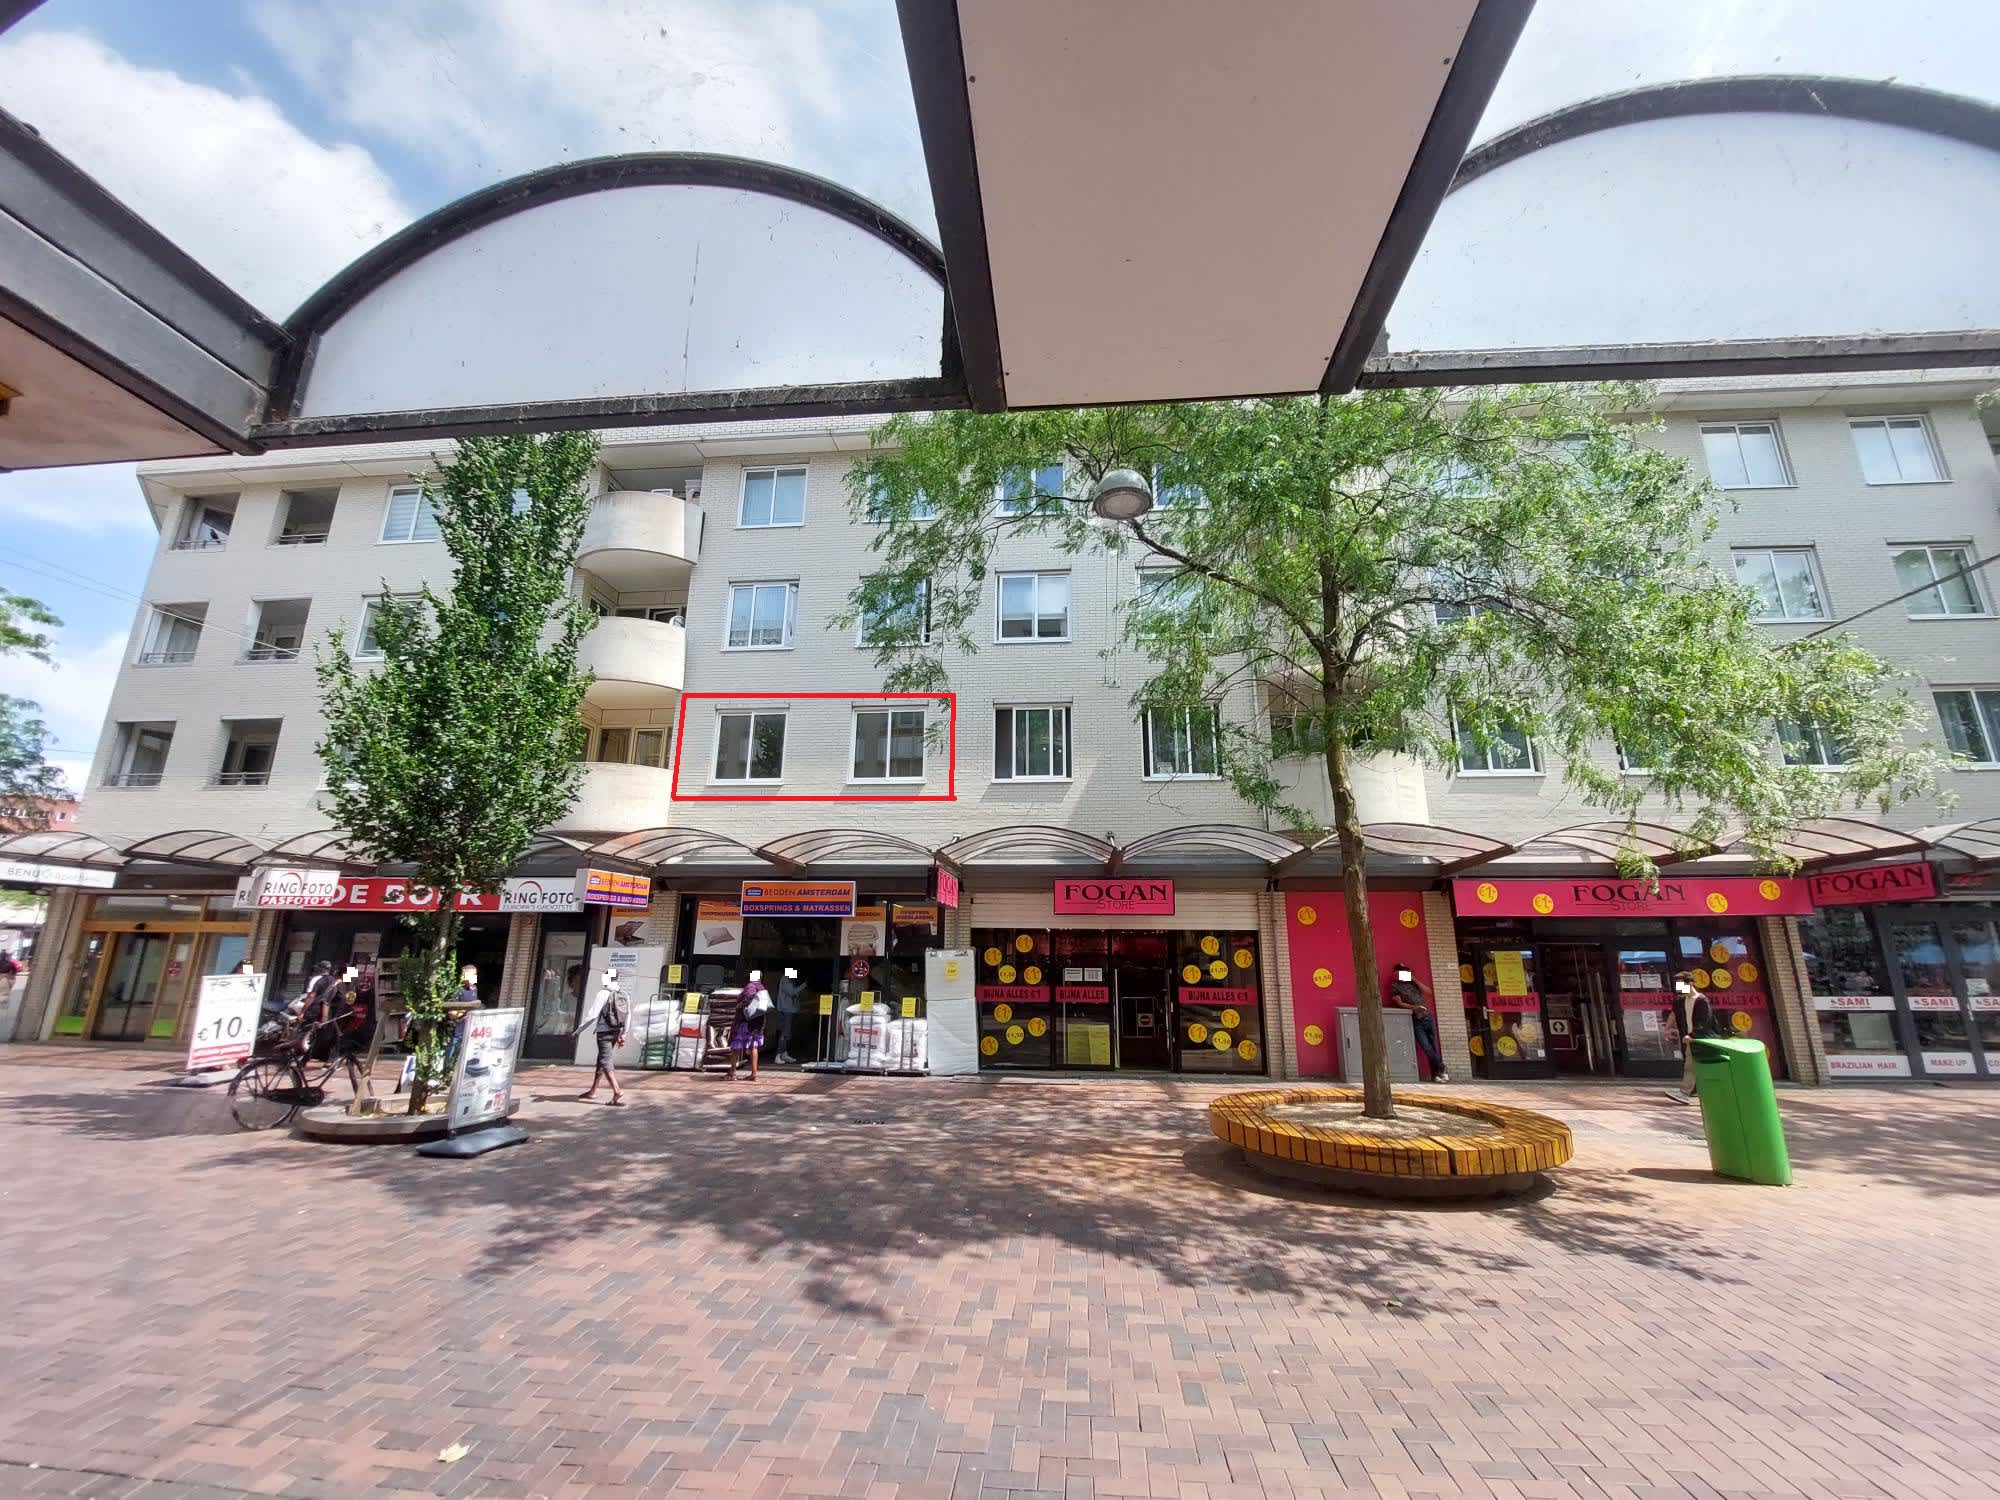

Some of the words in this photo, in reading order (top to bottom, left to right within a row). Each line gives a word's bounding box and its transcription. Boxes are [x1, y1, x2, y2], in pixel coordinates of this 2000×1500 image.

[7, 866, 41, 879] BENU
[1815, 867, 1927, 895] FOGAN
[300, 883, 333, 895] FOTO
[764, 888, 796, 896] BEDDEN
[796, 888, 850, 896] AMSTERDAM
[1065, 885, 1168, 901] FOGAN
[1573, 884, 1685, 902] FOGAN
[259, 896, 330, 905] PASFOTO'S
[384, 884, 481, 906] BOR
[743, 904, 793, 912] BOXSPRINGS
[802, 904, 851, 912] MATRASSEN
[1097, 900, 1136, 911] STORE
[1006, 988, 1029, 999] ALLES
[1060, 989, 1083, 1000] BIJNA
[1083, 989, 1105, 1000] ALLES
[1187, 991, 1210, 1001] BIJNA
[1211, 991, 1236, 1001] ALLES
[1837, 997, 1872, 1006] SAMI
[1921, 997, 1955, 1007] SAMI
[1982, 998, 2000, 1007] SA
[1830, 1061, 1873, 1069] BRAZILIAN
[1877, 1062, 1898, 1070] HAIR
